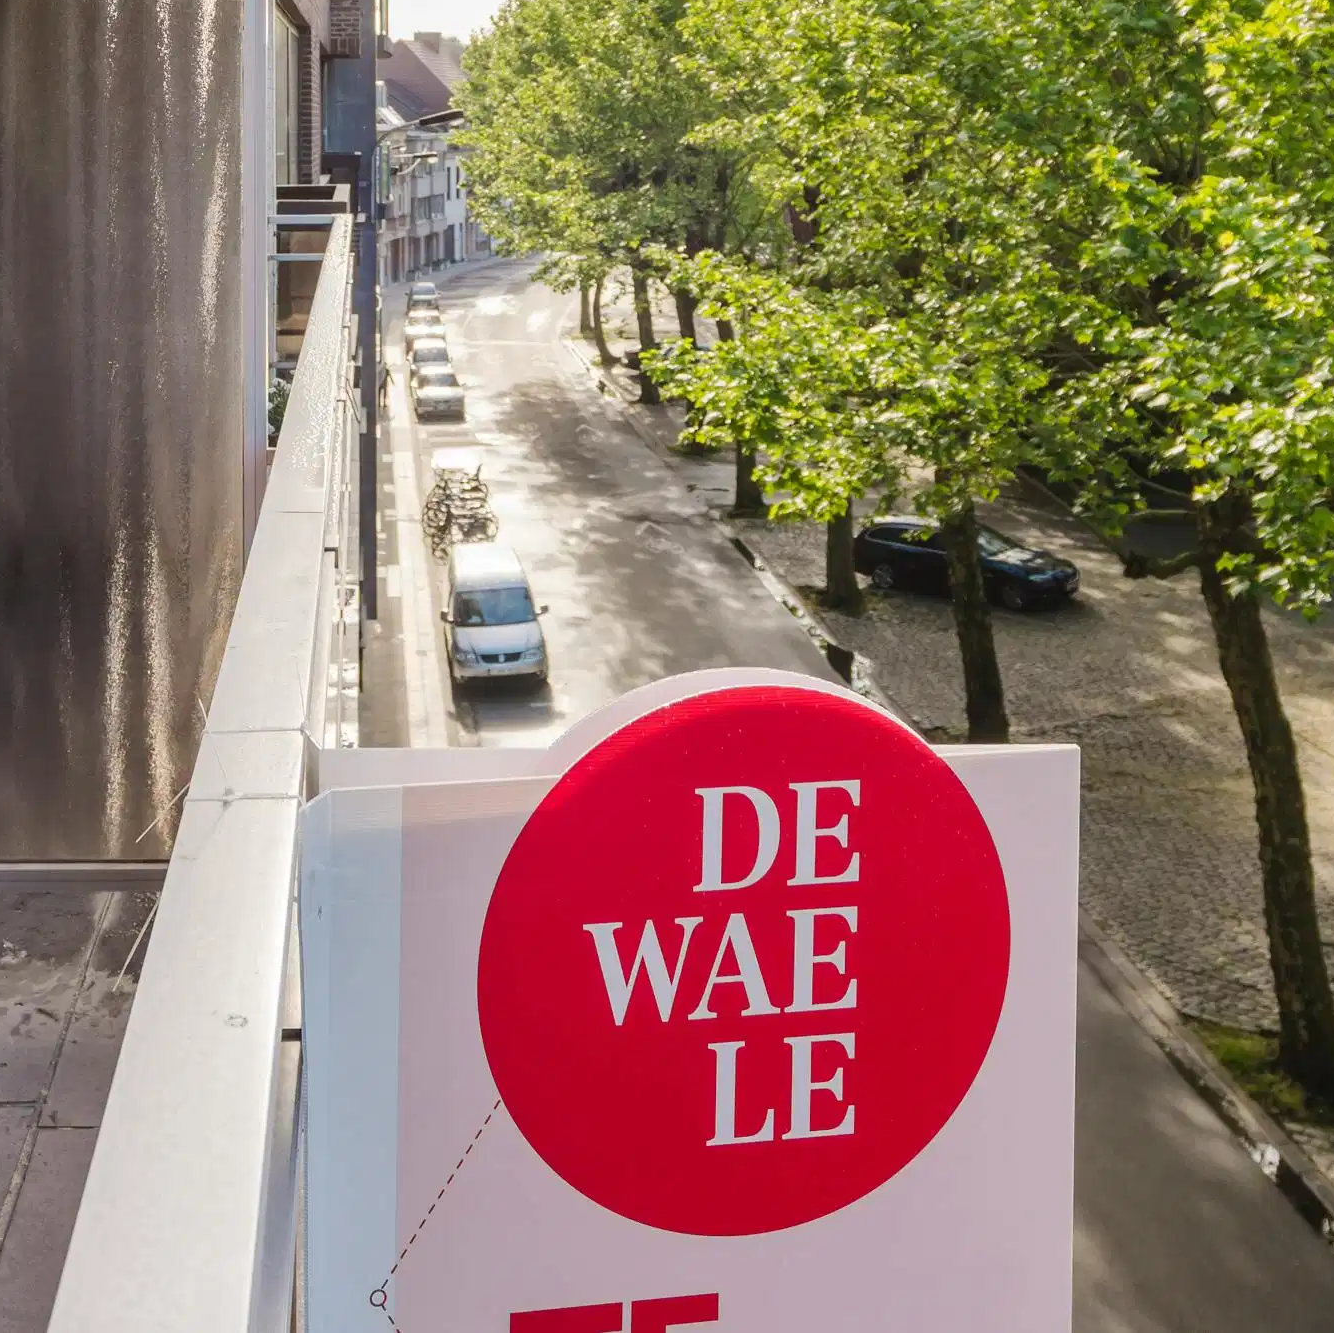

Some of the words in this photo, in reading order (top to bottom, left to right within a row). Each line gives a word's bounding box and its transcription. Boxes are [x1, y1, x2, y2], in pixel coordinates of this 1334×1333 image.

[693, 780, 860, 892] DE
[583, 906, 857, 1025] WAE
[706, 1033, 855, 1146] LE
